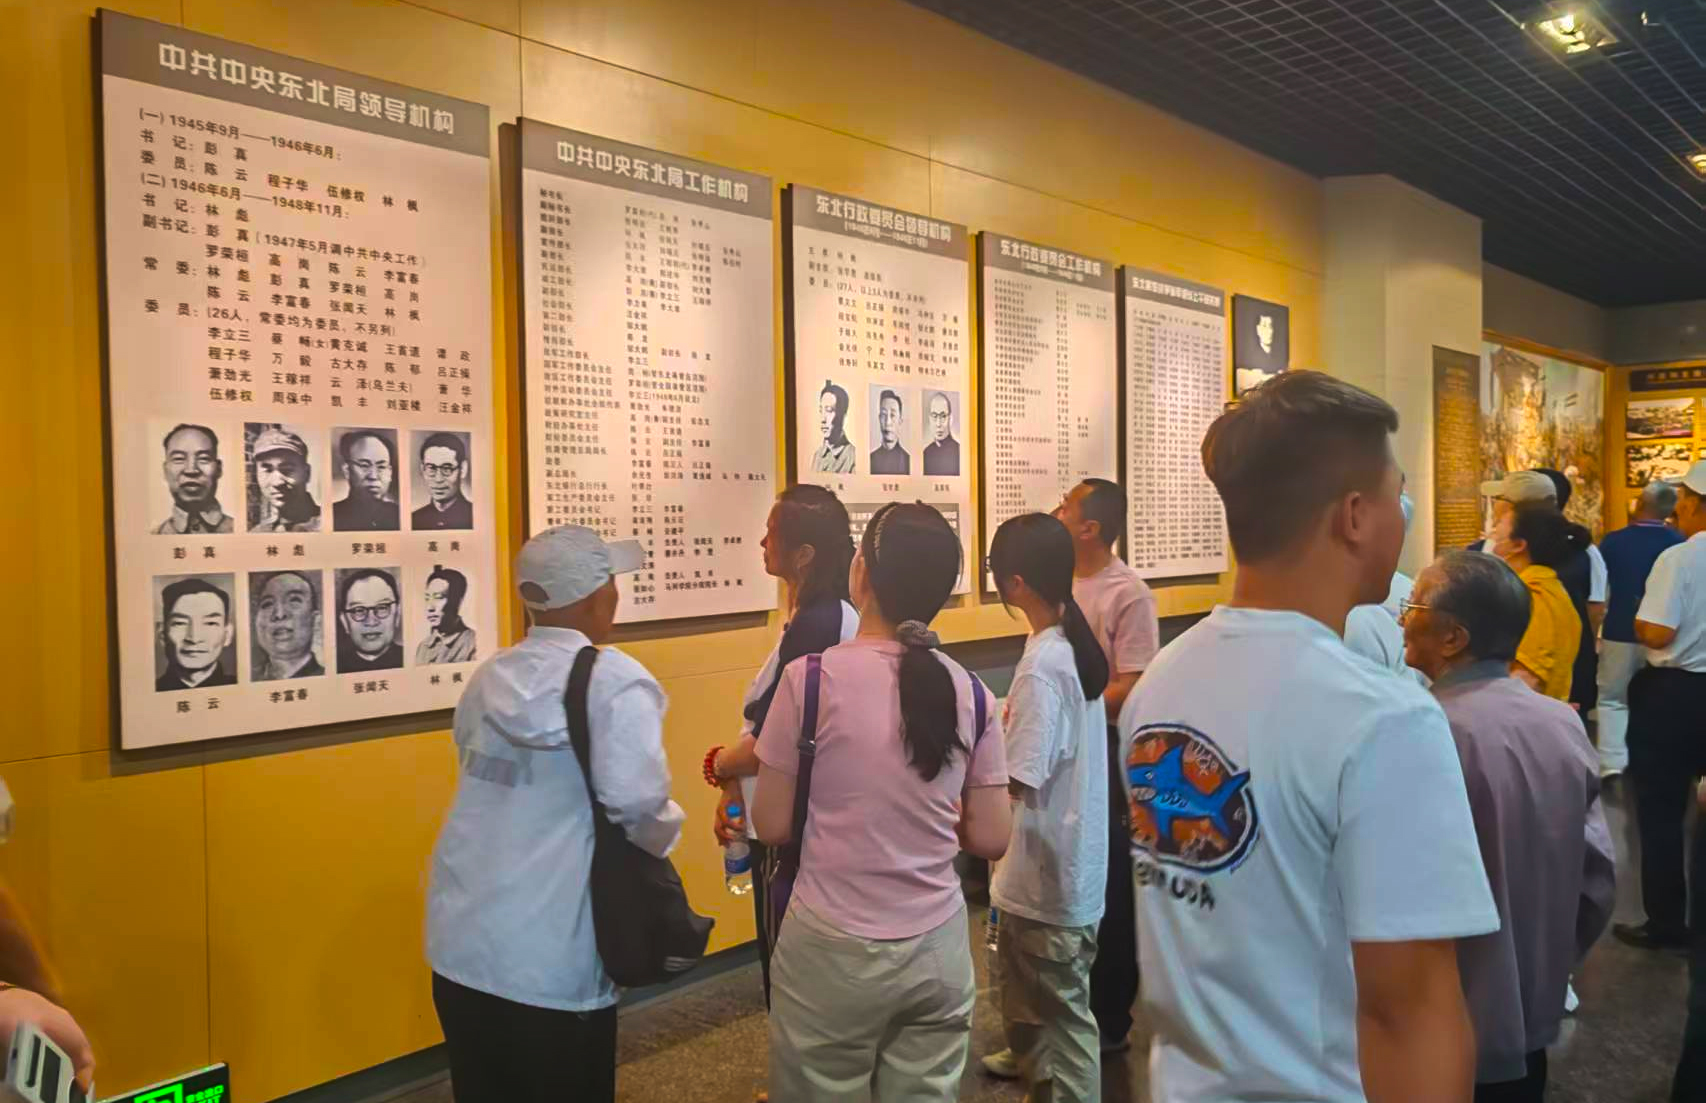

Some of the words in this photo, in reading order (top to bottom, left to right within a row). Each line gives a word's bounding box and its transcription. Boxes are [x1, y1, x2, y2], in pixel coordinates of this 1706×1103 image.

[158, 42, 455, 135] 中共中央东北局领导机构
[557, 141, 749, 203] 中共中央东北局工作机构
[267, 173, 308, 193] 程子华
[326, 184, 365, 203] 伍修权
[816, 194, 952, 242] 东北行政委员会领导机构
[383, 268, 419, 285] 李富春
[270, 292, 311, 309] 李富春
[207, 326, 251, 342] 李立三
[207, 346, 251, 362] 程子华
[209, 387, 252, 402] 伍修权
[269, 689, 309, 704] 李富春
